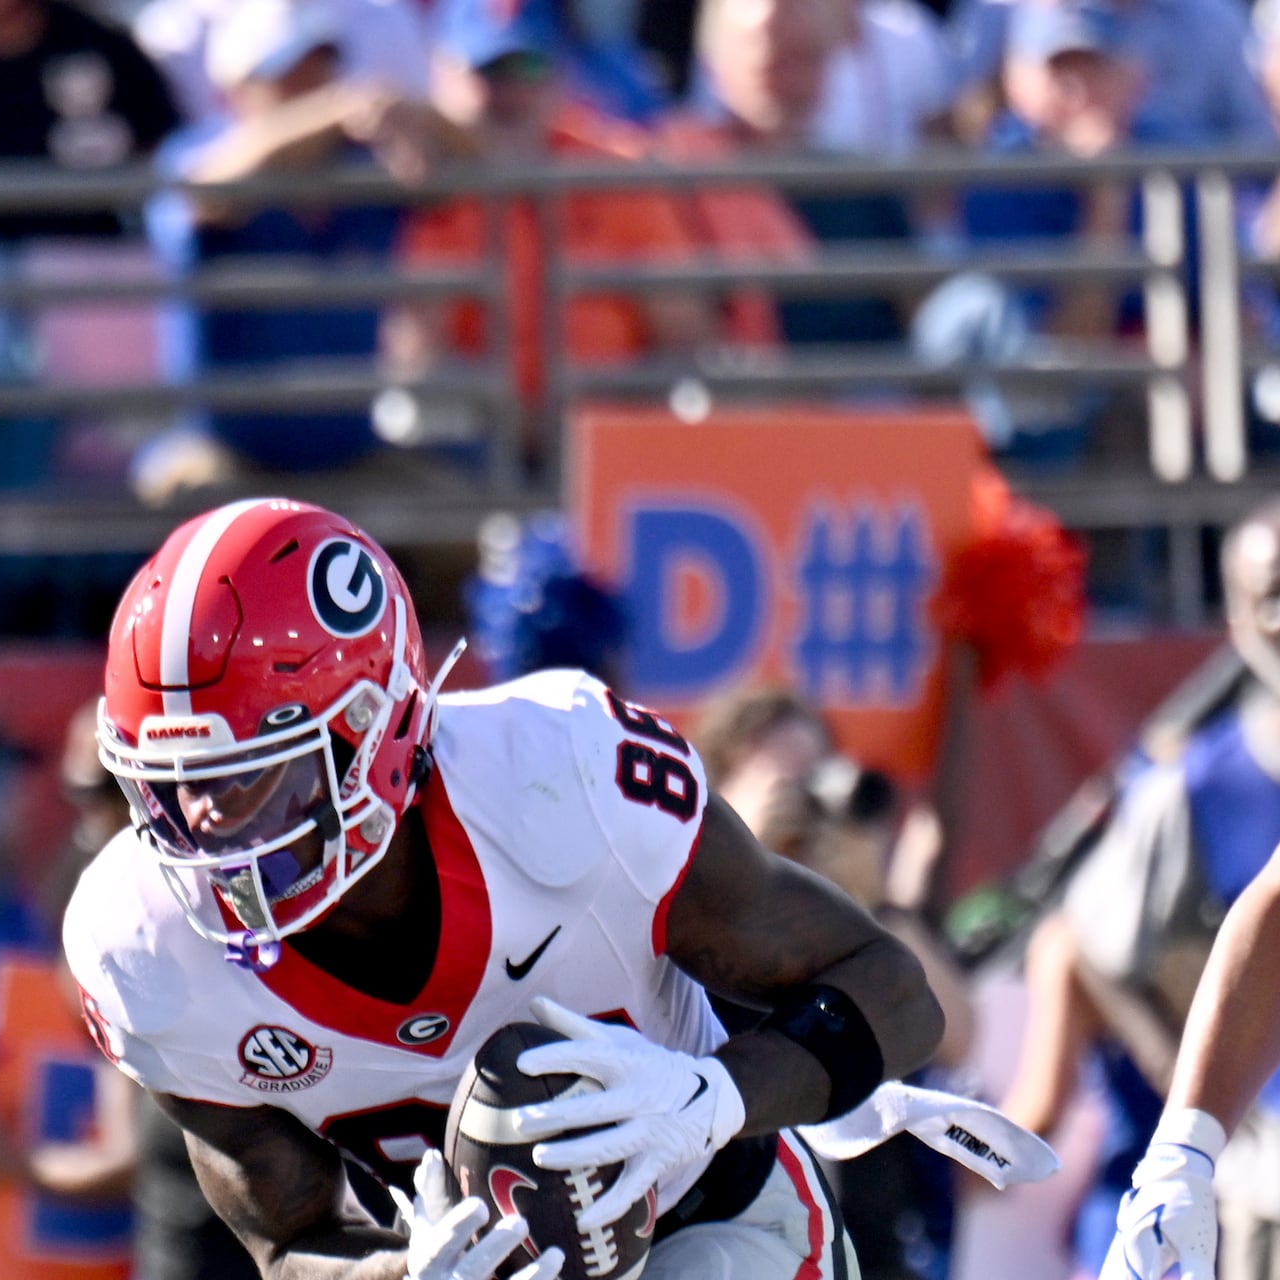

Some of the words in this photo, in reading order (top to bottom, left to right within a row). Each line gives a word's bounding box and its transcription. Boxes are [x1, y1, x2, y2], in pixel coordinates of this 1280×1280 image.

[308, 537, 387, 638] G
[146, 725, 211, 741] DAWGS
[396, 1013, 450, 1045] G
[242, 1028, 310, 1078] SEC
[257, 1062, 328, 1093] GRADUATE
